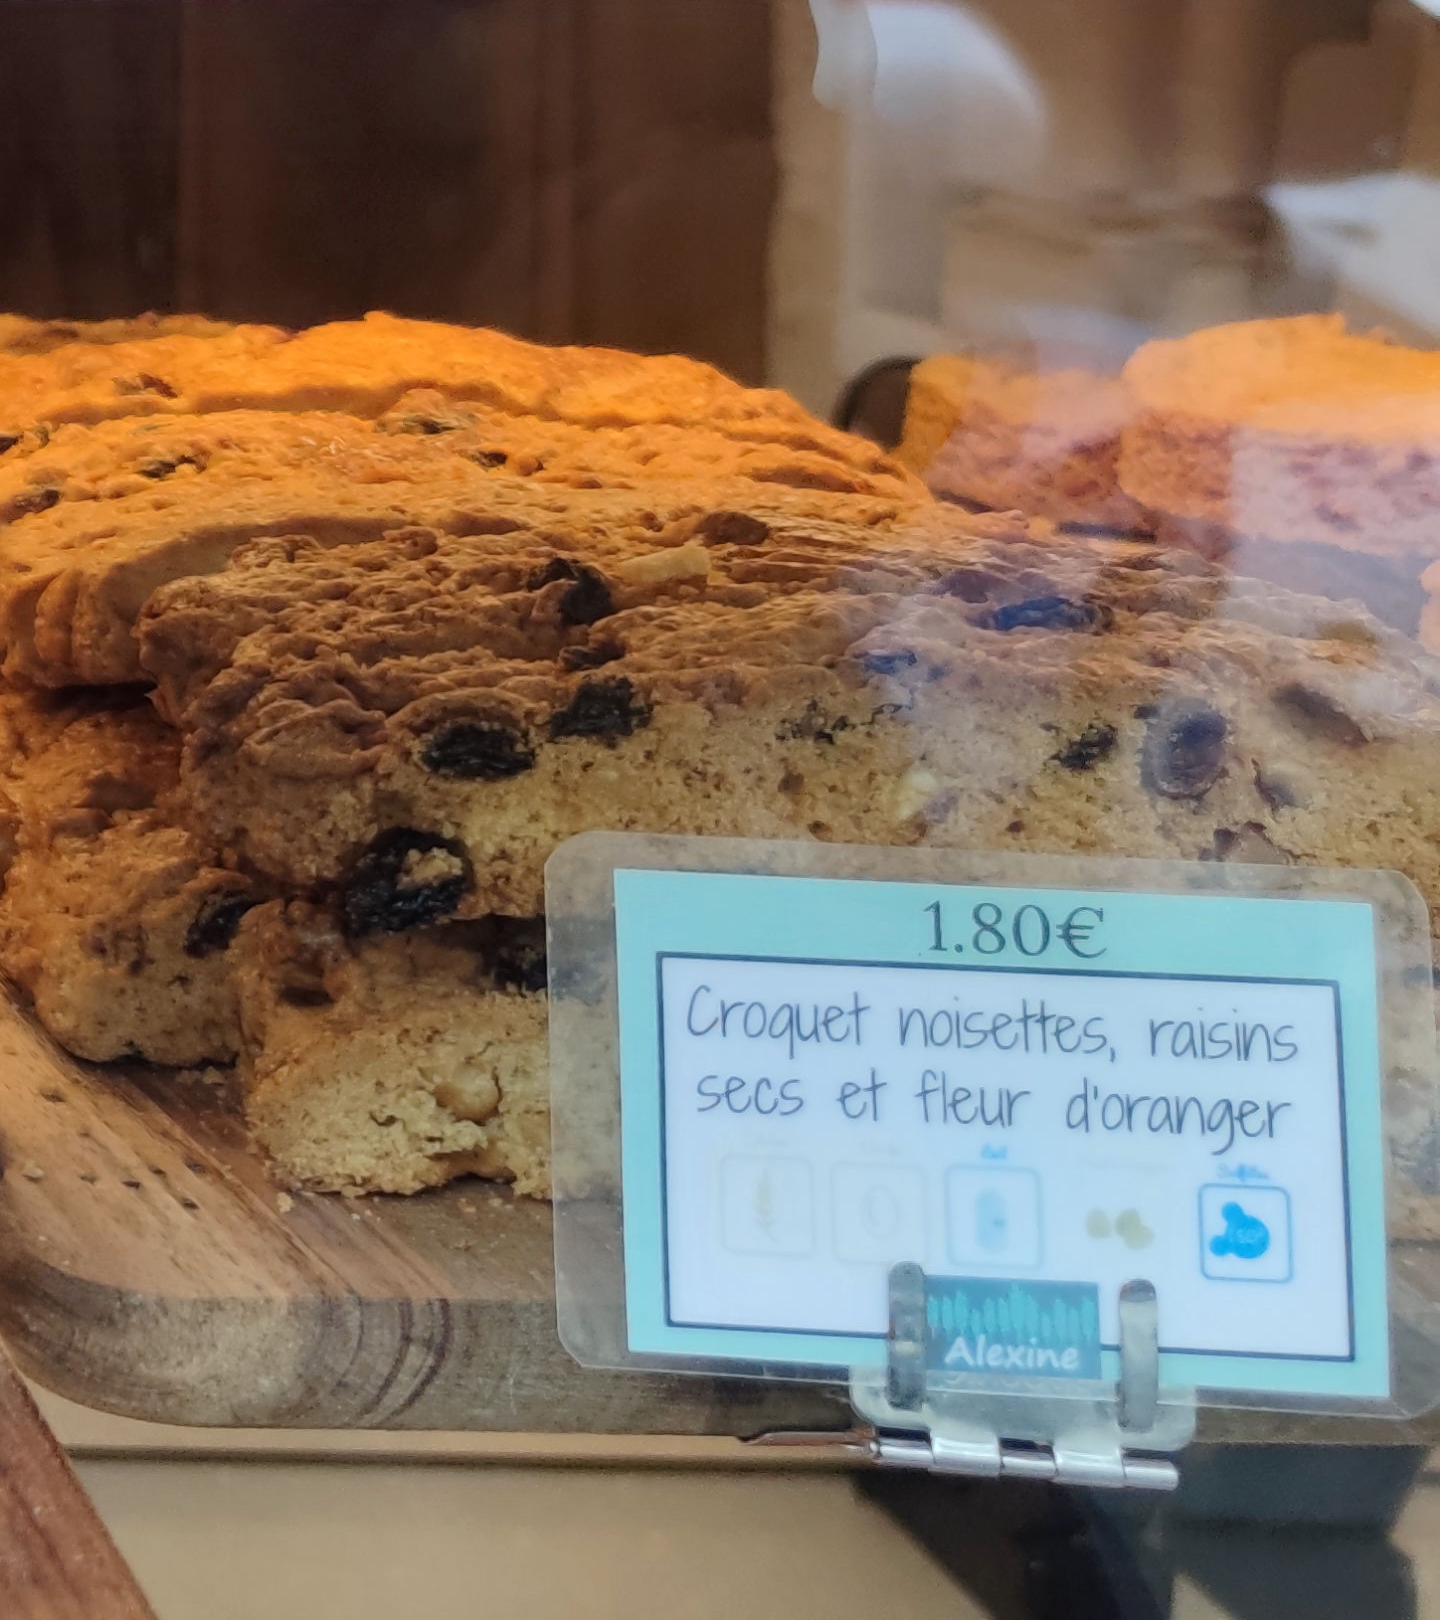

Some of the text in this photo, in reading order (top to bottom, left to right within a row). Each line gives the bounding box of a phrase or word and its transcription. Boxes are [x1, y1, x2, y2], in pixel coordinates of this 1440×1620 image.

[923, 899, 1108, 960] 1.80€
[686, 984, 1300, 1063] Croquet noisettes, raisins
[696, 1067, 1293, 1157] secs et fleur d'oranger
[944, 1335, 1080, 1372] Alexine
